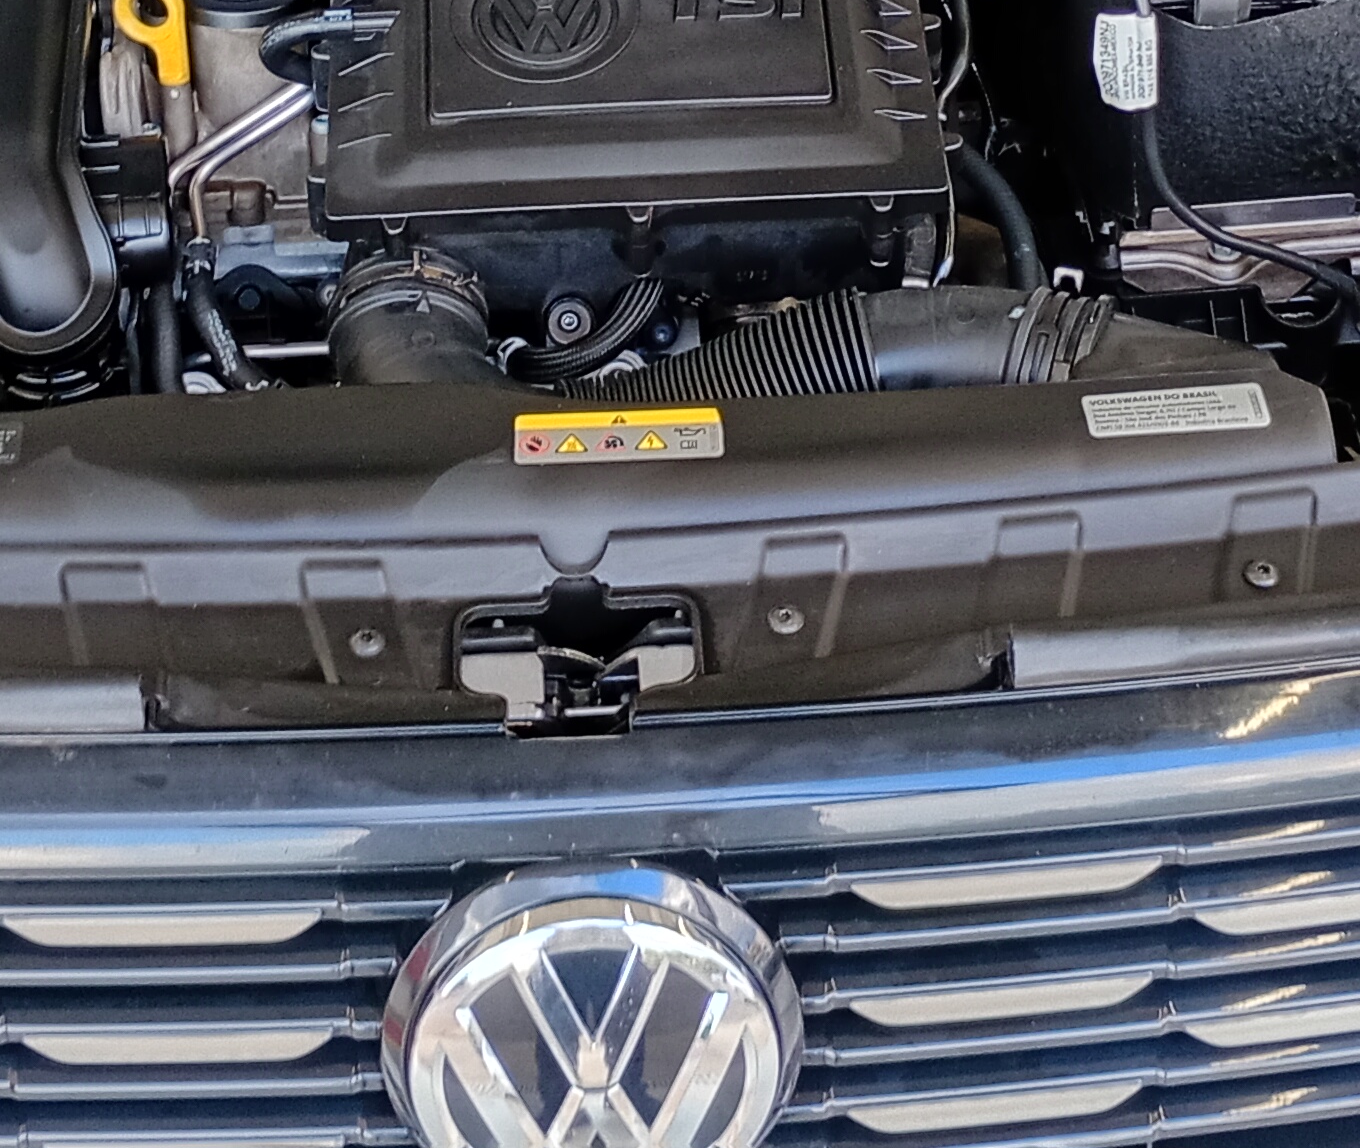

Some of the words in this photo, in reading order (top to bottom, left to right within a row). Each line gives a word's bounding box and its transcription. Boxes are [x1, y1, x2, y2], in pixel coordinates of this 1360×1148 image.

[1089, 394, 1162, 407] VOLKSWAGEN
[1164, 393, 1180, 401] DO
[1183, 390, 1218, 399] BRASIL
